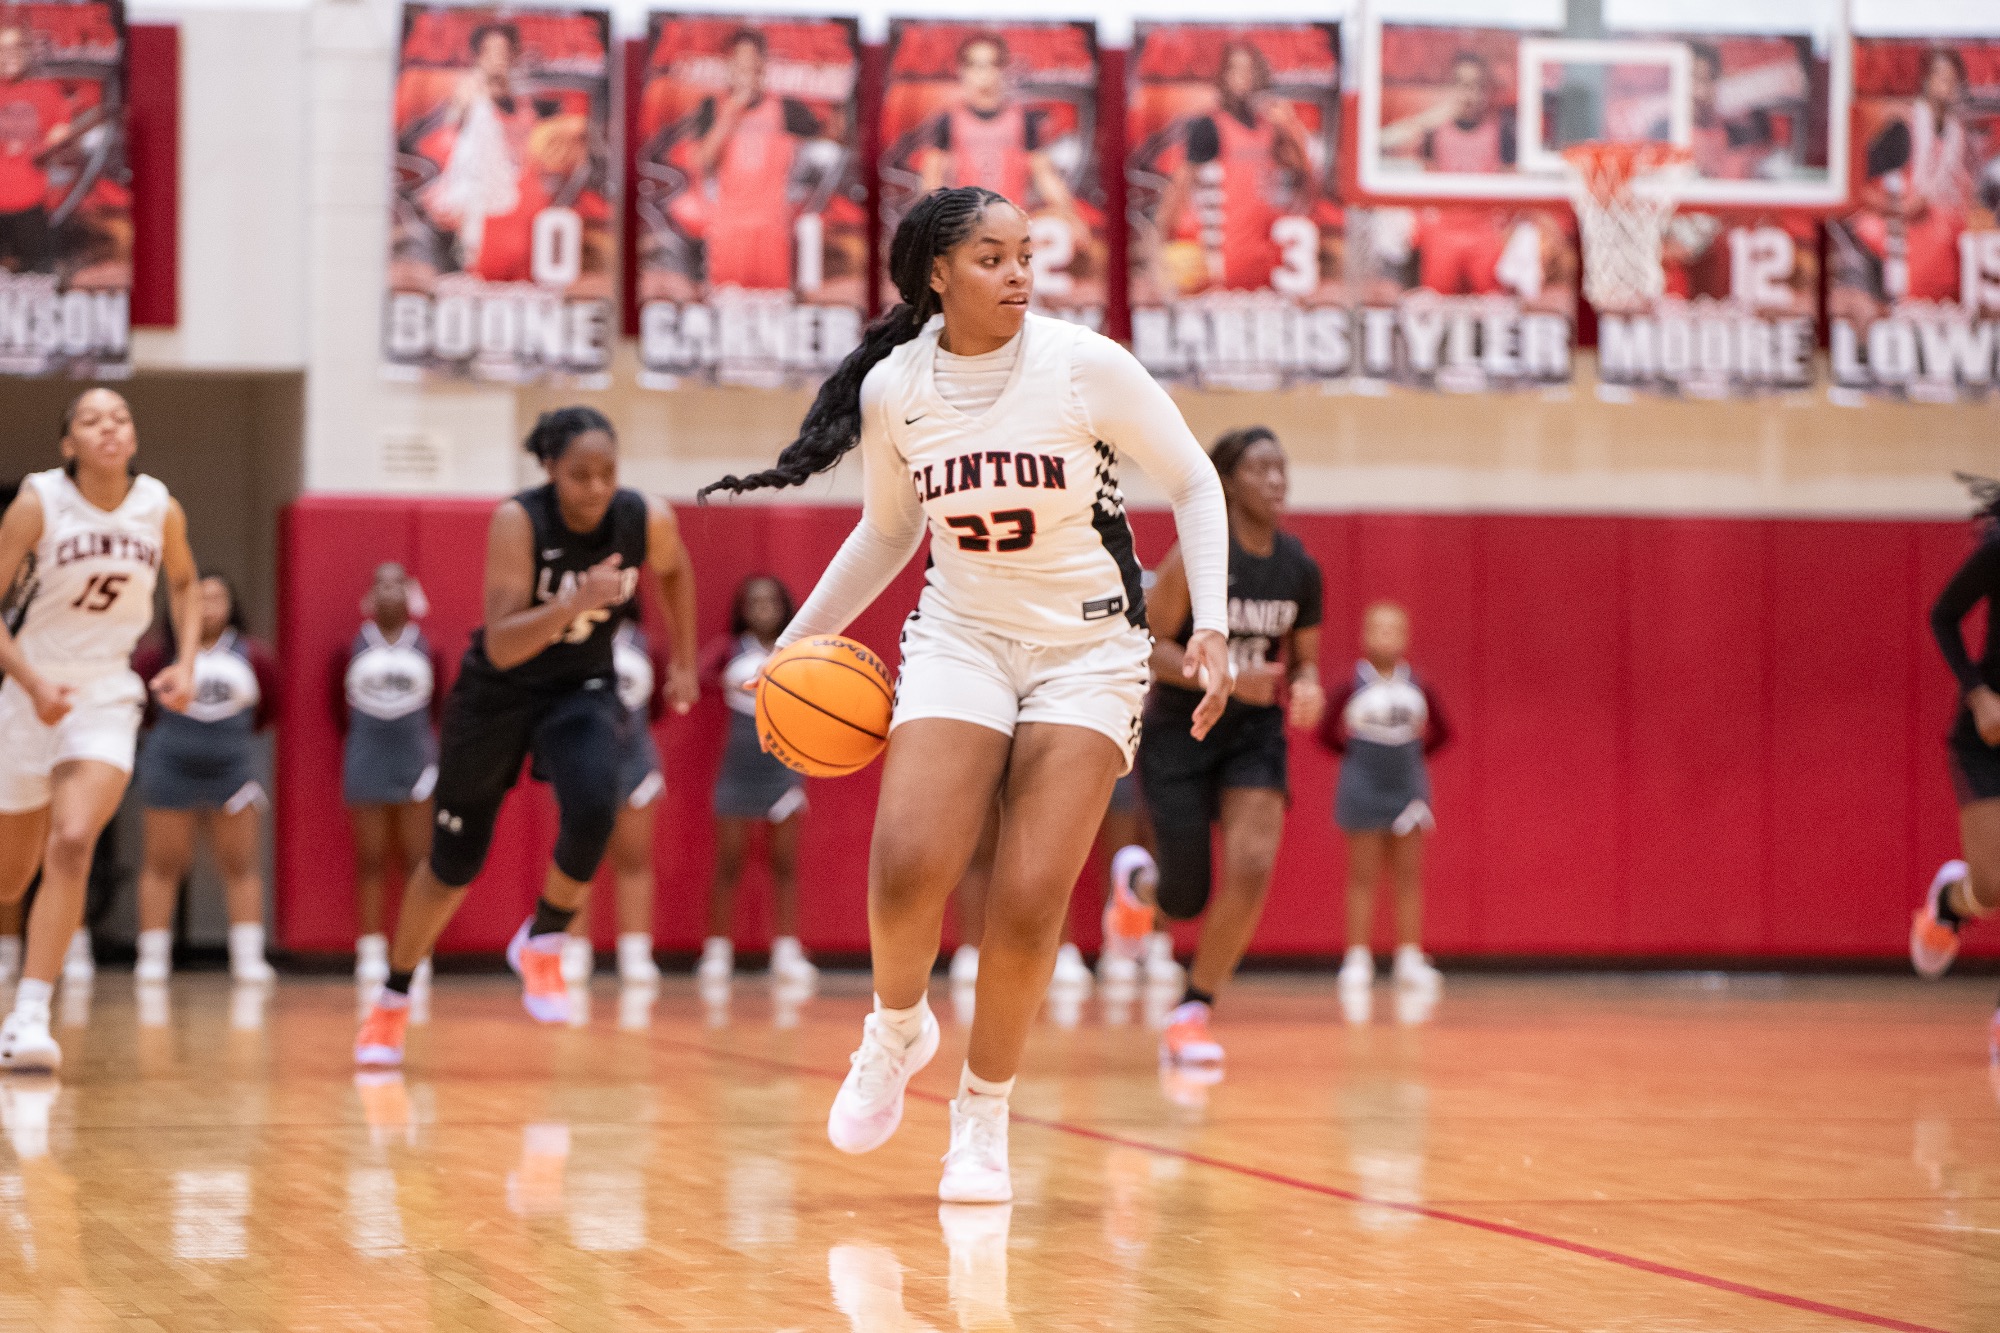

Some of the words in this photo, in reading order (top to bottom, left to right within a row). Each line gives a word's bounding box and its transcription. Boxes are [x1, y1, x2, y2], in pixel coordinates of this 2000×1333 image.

[531, 208, 584, 283] 0
[797, 213, 824, 293] 1
[1030, 217, 1072, 297] 2
[1269, 215, 1320, 297] 3
[1495, 221, 1541, 299] 4
[1726, 227, 1796, 307] 12
[391, 295, 606, 361] BOONE
[1363, 309, 1572, 377] TYLER
[1600, 317, 1813, 379] MOORE
[912, 450, 1068, 504] CLINTON
[944, 507, 1037, 553] 23
[70, 573, 132, 614] 15
